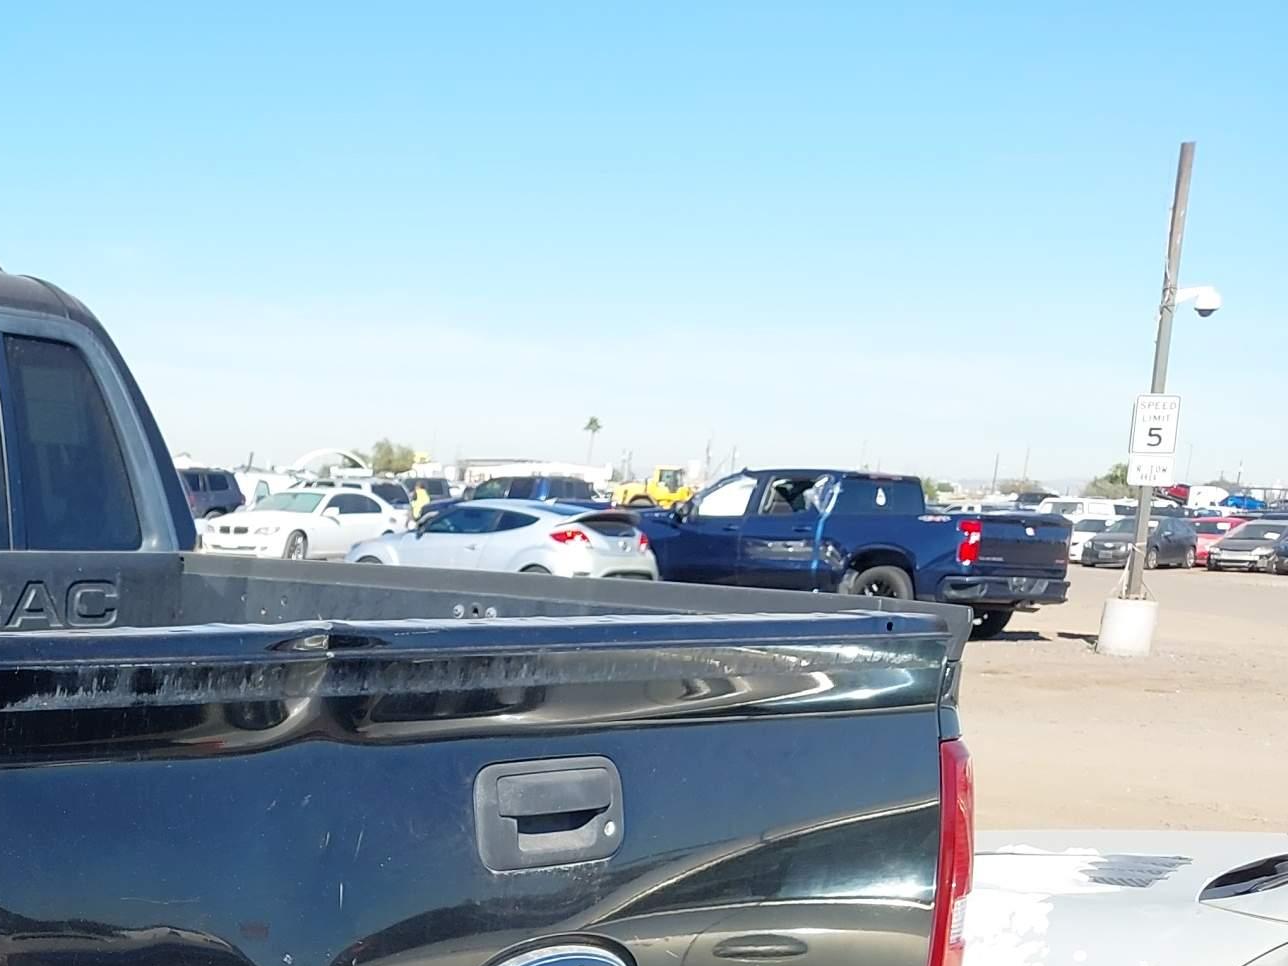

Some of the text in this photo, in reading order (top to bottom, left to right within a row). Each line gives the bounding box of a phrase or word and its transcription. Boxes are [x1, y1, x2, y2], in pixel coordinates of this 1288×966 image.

[1140, 401, 1177, 410] SPEED
[1142, 414, 1171, 423] LIMIT
[1146, 427, 1163, 447] 5
